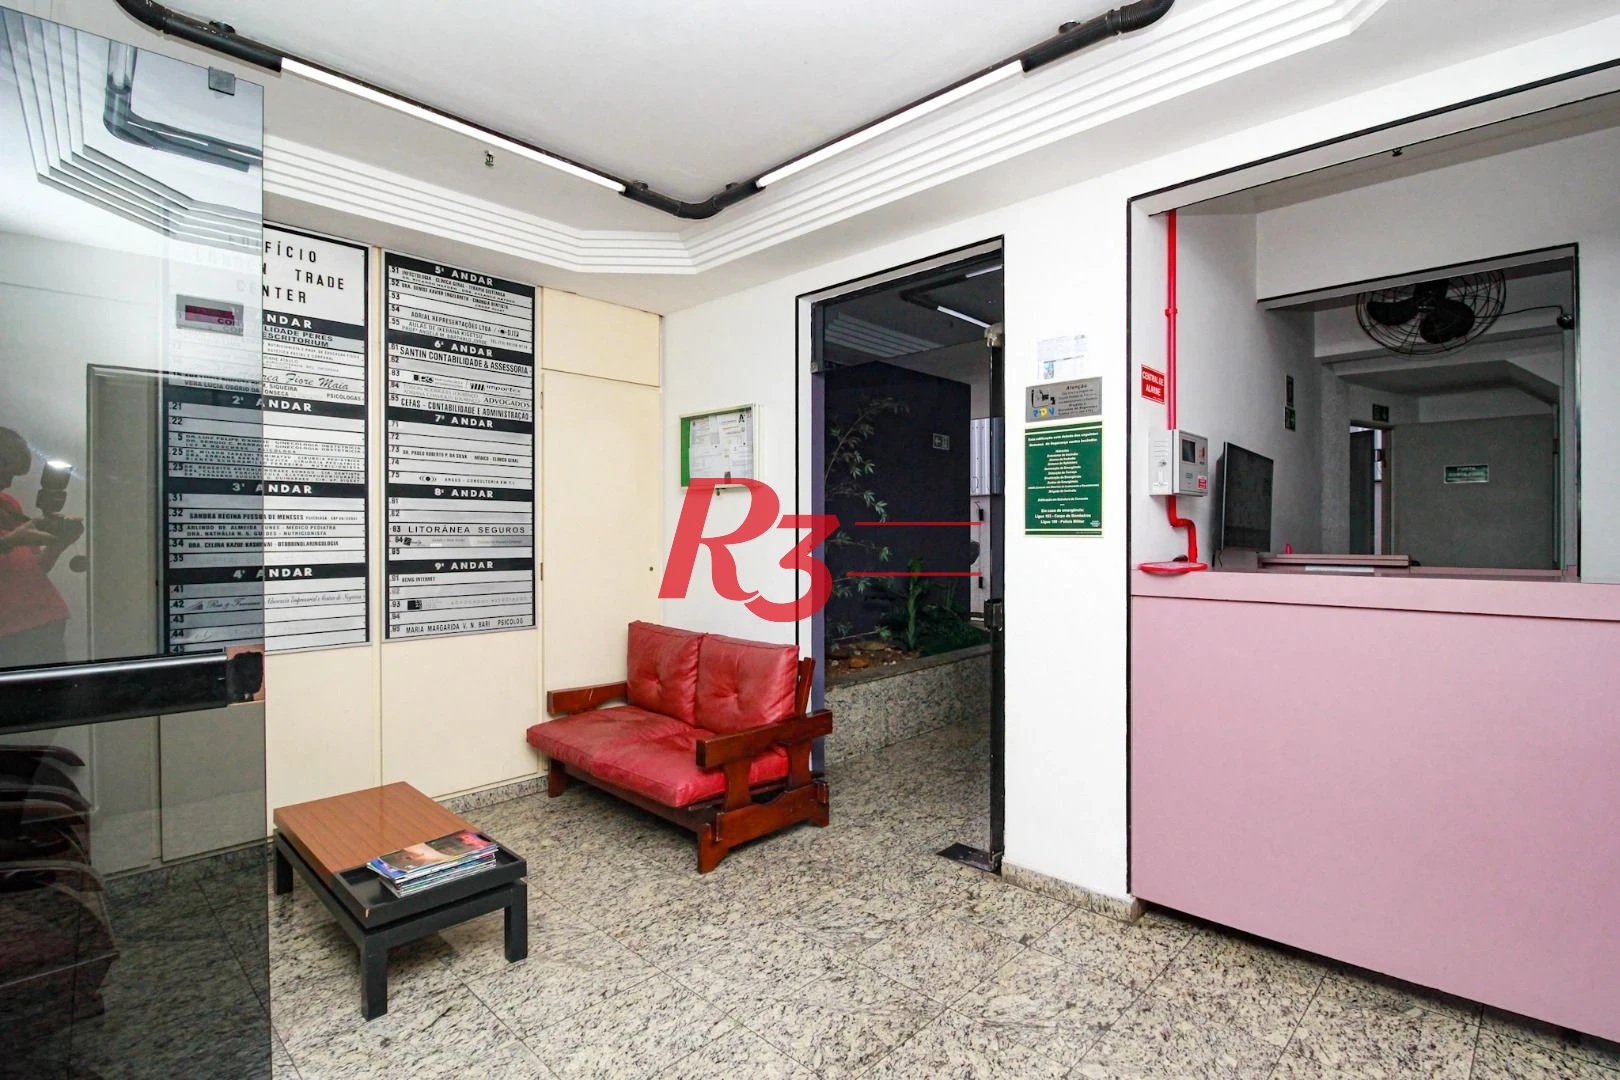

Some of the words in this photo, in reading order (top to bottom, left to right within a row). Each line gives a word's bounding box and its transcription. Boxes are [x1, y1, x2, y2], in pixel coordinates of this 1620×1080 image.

[295, 268, 344, 290] TRADE
[451, 270, 494, 286] ANDAR
[302, 329, 333, 342] PERES
[451, 343, 493, 357] ANDAR
[400, 346, 427, 359] SANTIN
[429, 351, 482, 368] CONTABILIDADE
[484, 361, 489, 369] &
[490, 361, 529, 375] ASSESSORIA
[256, 397, 312, 411] ANDAR
[401, 398, 421, 408] CEFAS
[428, 401, 476, 416] CONTABILIDADE
[484, 397, 530, 408] ADVOGADOS
[451, 416, 494, 428] ANDAR
[256, 484, 312, 494] ANDAR
[451, 488, 494, 498] ANDAR
[408, 524, 470, 534] LITORÂNEA
[478, 526, 525, 534] SEGUROS
[451, 560, 494, 570] ANDAR
[256, 568, 313, 579] ANDAR
[406, 624, 424, 633] MARIA
[427, 621, 460, 632] MARGARIDA
